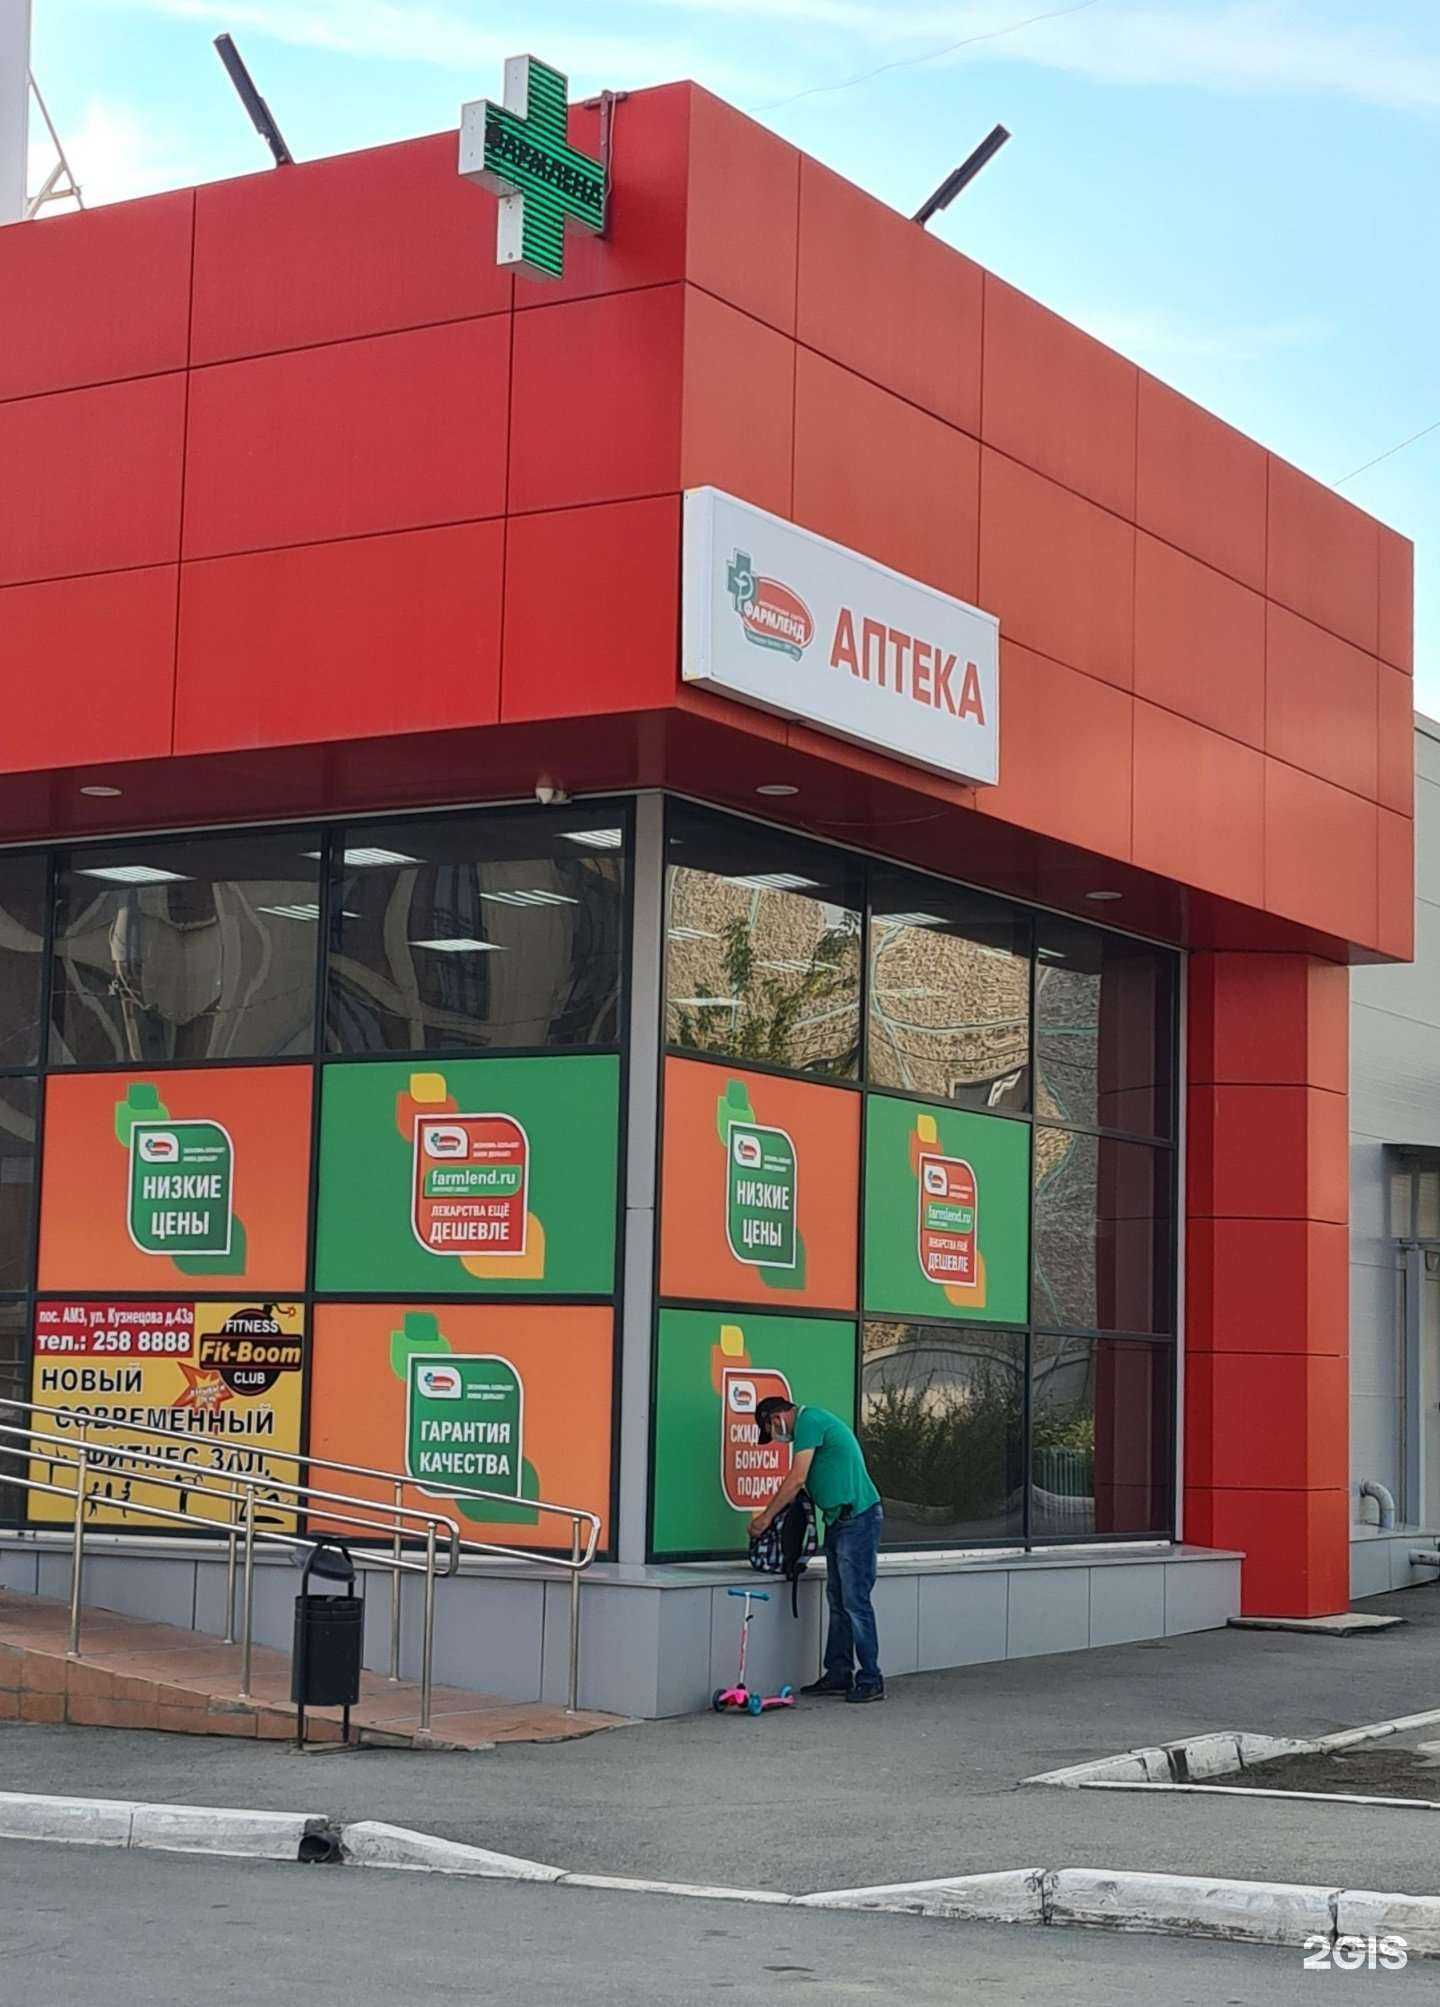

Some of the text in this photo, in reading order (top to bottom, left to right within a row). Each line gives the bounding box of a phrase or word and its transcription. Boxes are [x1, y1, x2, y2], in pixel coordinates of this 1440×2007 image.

[744, 600, 805, 643] ФАРМЛЕНД
[830, 607, 985, 726] АПТЕКА
[142, 1174, 222, 1199] НИЗКИЕ
[432, 1169, 515, 1185] farmlend.ru
[736, 1180, 789, 1210] НИЗКИЕ
[431, 1205, 486, 1217] ЛЕКАРСТВА
[151, 1211, 210, 1239] ЦЕНЫ
[429, 1222, 510, 1243] ДЕШЕВЛЕ
[743, 1219, 782, 1248] ЦЕНЫ
[928, 1252, 968, 1273] ДЕШЕВЛЕ
[107, 1307, 163, 1328] Кузнецова
[225, 1319, 279, 1334] FITNESS
[37, 1331, 190, 1351] тел.: 258 8888
[200, 1341, 301, 1363] Fit-Boom
[41, 1363, 142, 1392] НОВЫЙ
[233, 1371, 266, 1385] CLUB
[420, 1421, 510, 1443] ГАРАНТИЯ
[730, 1423, 761, 1447] СКИД
[420, 1452, 510, 1475] КАЧЕСТВА
[735, 1450, 779, 1469] БОНУСЫ
[737, 1475, 786, 1499] ПОДАРК
